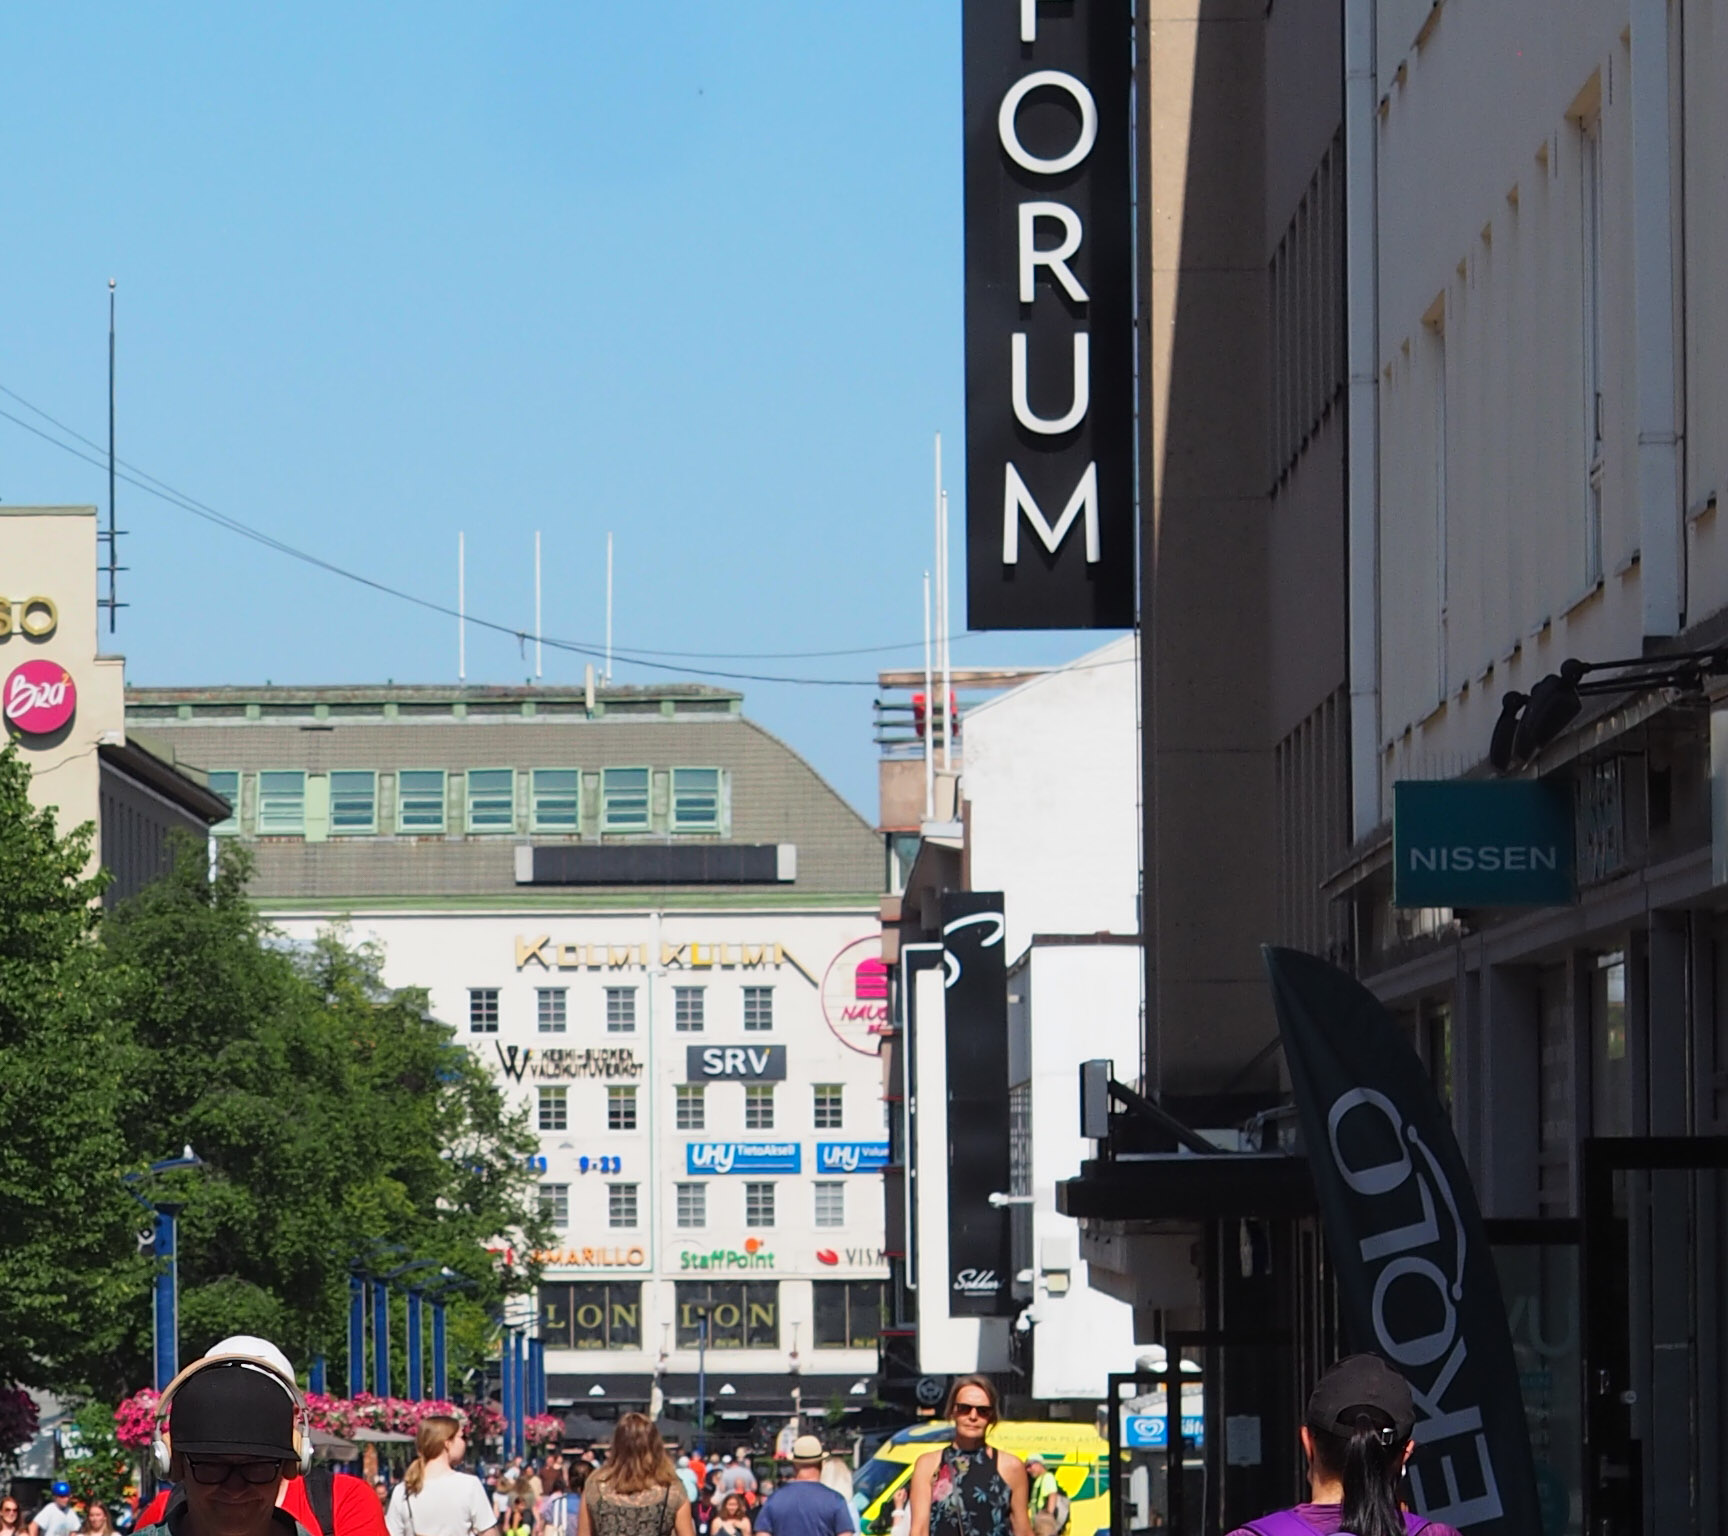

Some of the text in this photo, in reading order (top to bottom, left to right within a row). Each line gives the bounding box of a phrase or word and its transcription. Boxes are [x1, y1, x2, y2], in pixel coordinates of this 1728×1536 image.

[1409, 846, 1558, 872] NISSEN
[515, 935, 648, 967] KOLMI
[702, 1047, 771, 1076] SRV
[680, 1247, 776, 1270] StaffPoint
[1327, 1086, 1505, 1529] EKOLO
